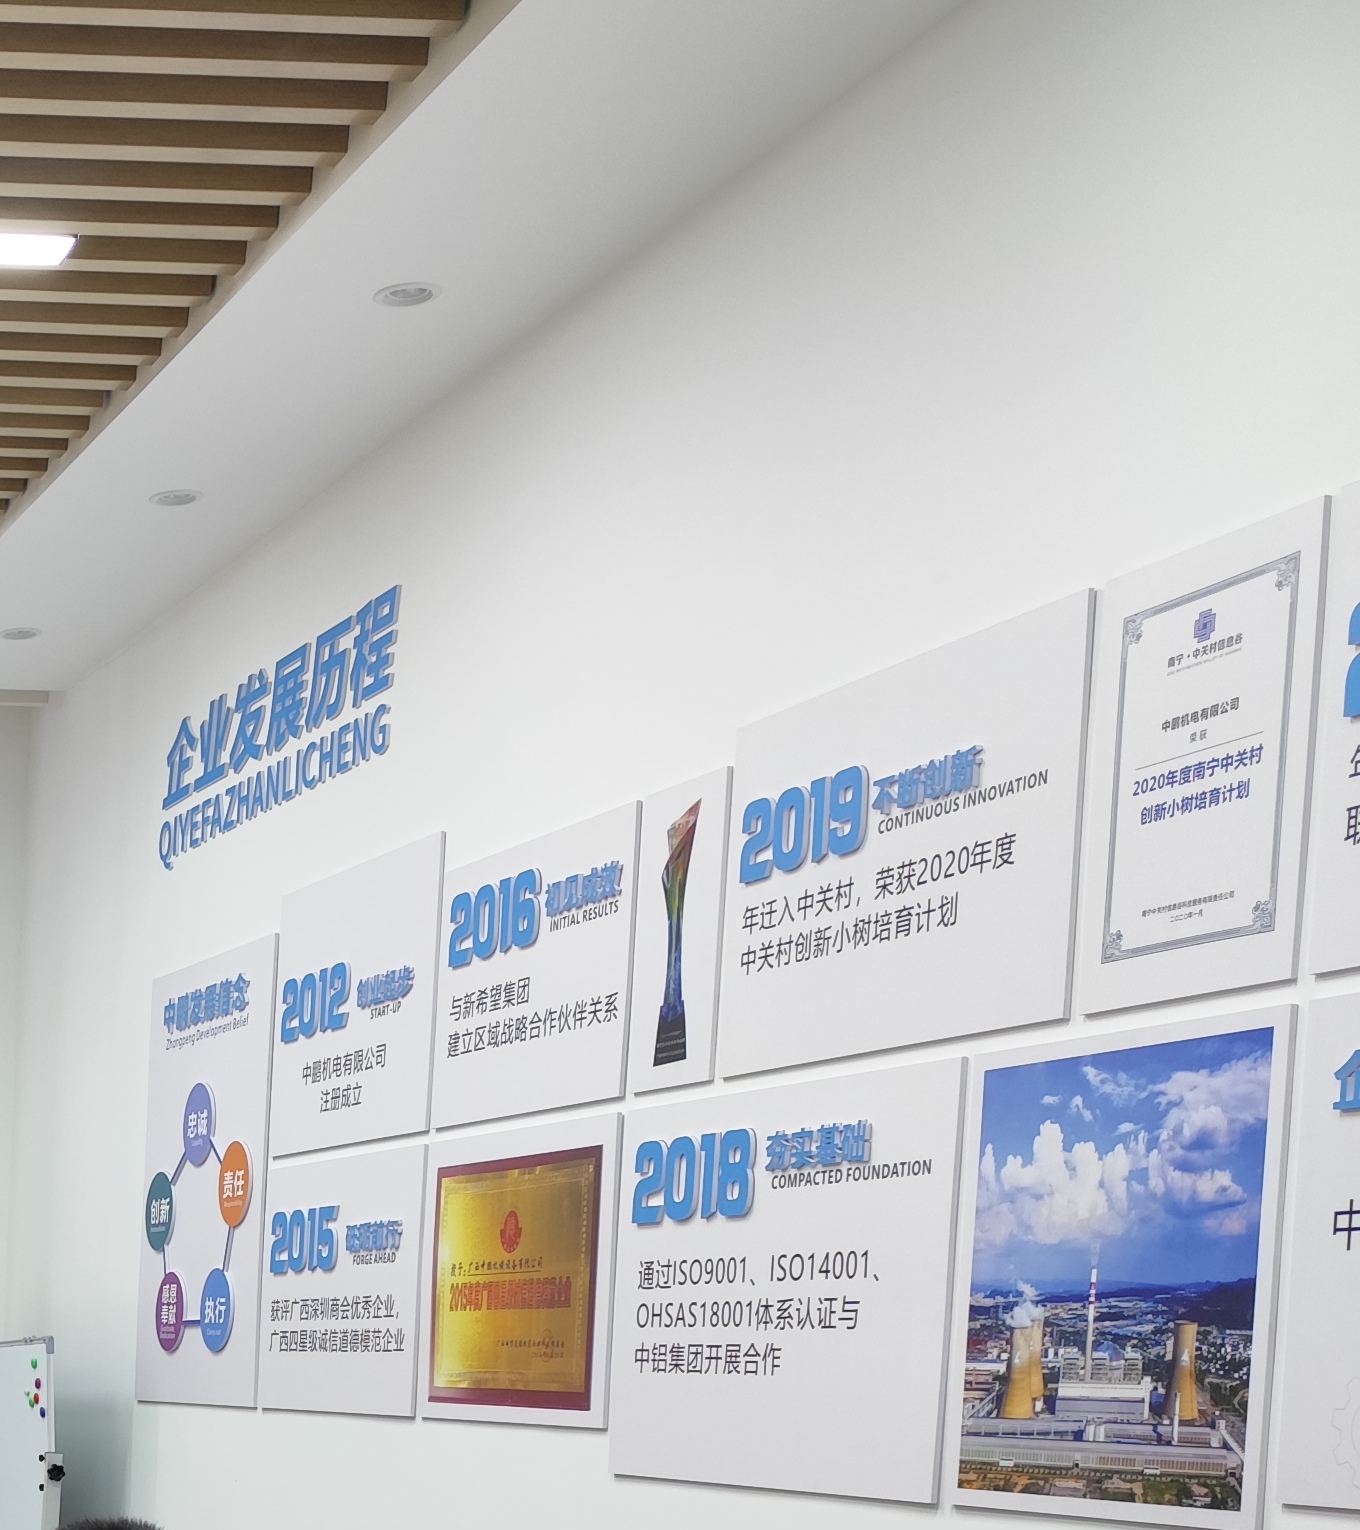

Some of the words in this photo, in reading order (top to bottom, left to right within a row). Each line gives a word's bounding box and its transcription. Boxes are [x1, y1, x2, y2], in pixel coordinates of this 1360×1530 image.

[162, 585, 402, 810] 企业发展历程
[159, 704, 391, 870] QIYEFAZHANLICHENG
[1133, 743, 1263, 796] 2020年度南宁中关村
[739, 765, 869, 887] 2019
[872, 745, 984, 814] 不断创新
[878, 797, 960, 835] CONTINUOUS
[963, 769, 1049, 808] INNOVATION
[1141, 778, 1250, 825] 创新小树培育计划
[448, 868, 542, 969] 2016
[550, 913, 581, 932] INITIAL
[583, 900, 619, 922] RESULTS
[740, 891, 959, 975] 中关村创新小树培育计划
[281, 962, 351, 1043] 2012
[370, 1001, 401, 1019] START-UP
[450, 977, 530, 1021] 与新希望集团
[447, 992, 619, 1058] 建立区域战略合作伙伴关系
[302, 1044, 387, 1085] 中鹏机电有限公司
[320, 1082, 362, 1113] 注册成立
[187, 1109, 208, 1138] 忠诚
[223, 1169, 244, 1198] 责任
[632, 1127, 758, 1227] 2018
[766, 1119, 873, 1172] 夯实基础
[771, 1169, 843, 1189] COMPACTED
[846, 1159, 932, 1183] FOUNDATION
[150, 1197, 170, 1224] 创新
[270, 1205, 340, 1274] 2015
[374, 1252, 396, 1264] AHEAD
[205, 1297, 226, 1323] 执行
[636, 1295, 860, 1331] OHSAS18001体系认证与
[269, 1328, 405, 1353] 广西四星级诚信道德模范企业
[634, 1342, 782, 1376] 中铝集团开展合作
